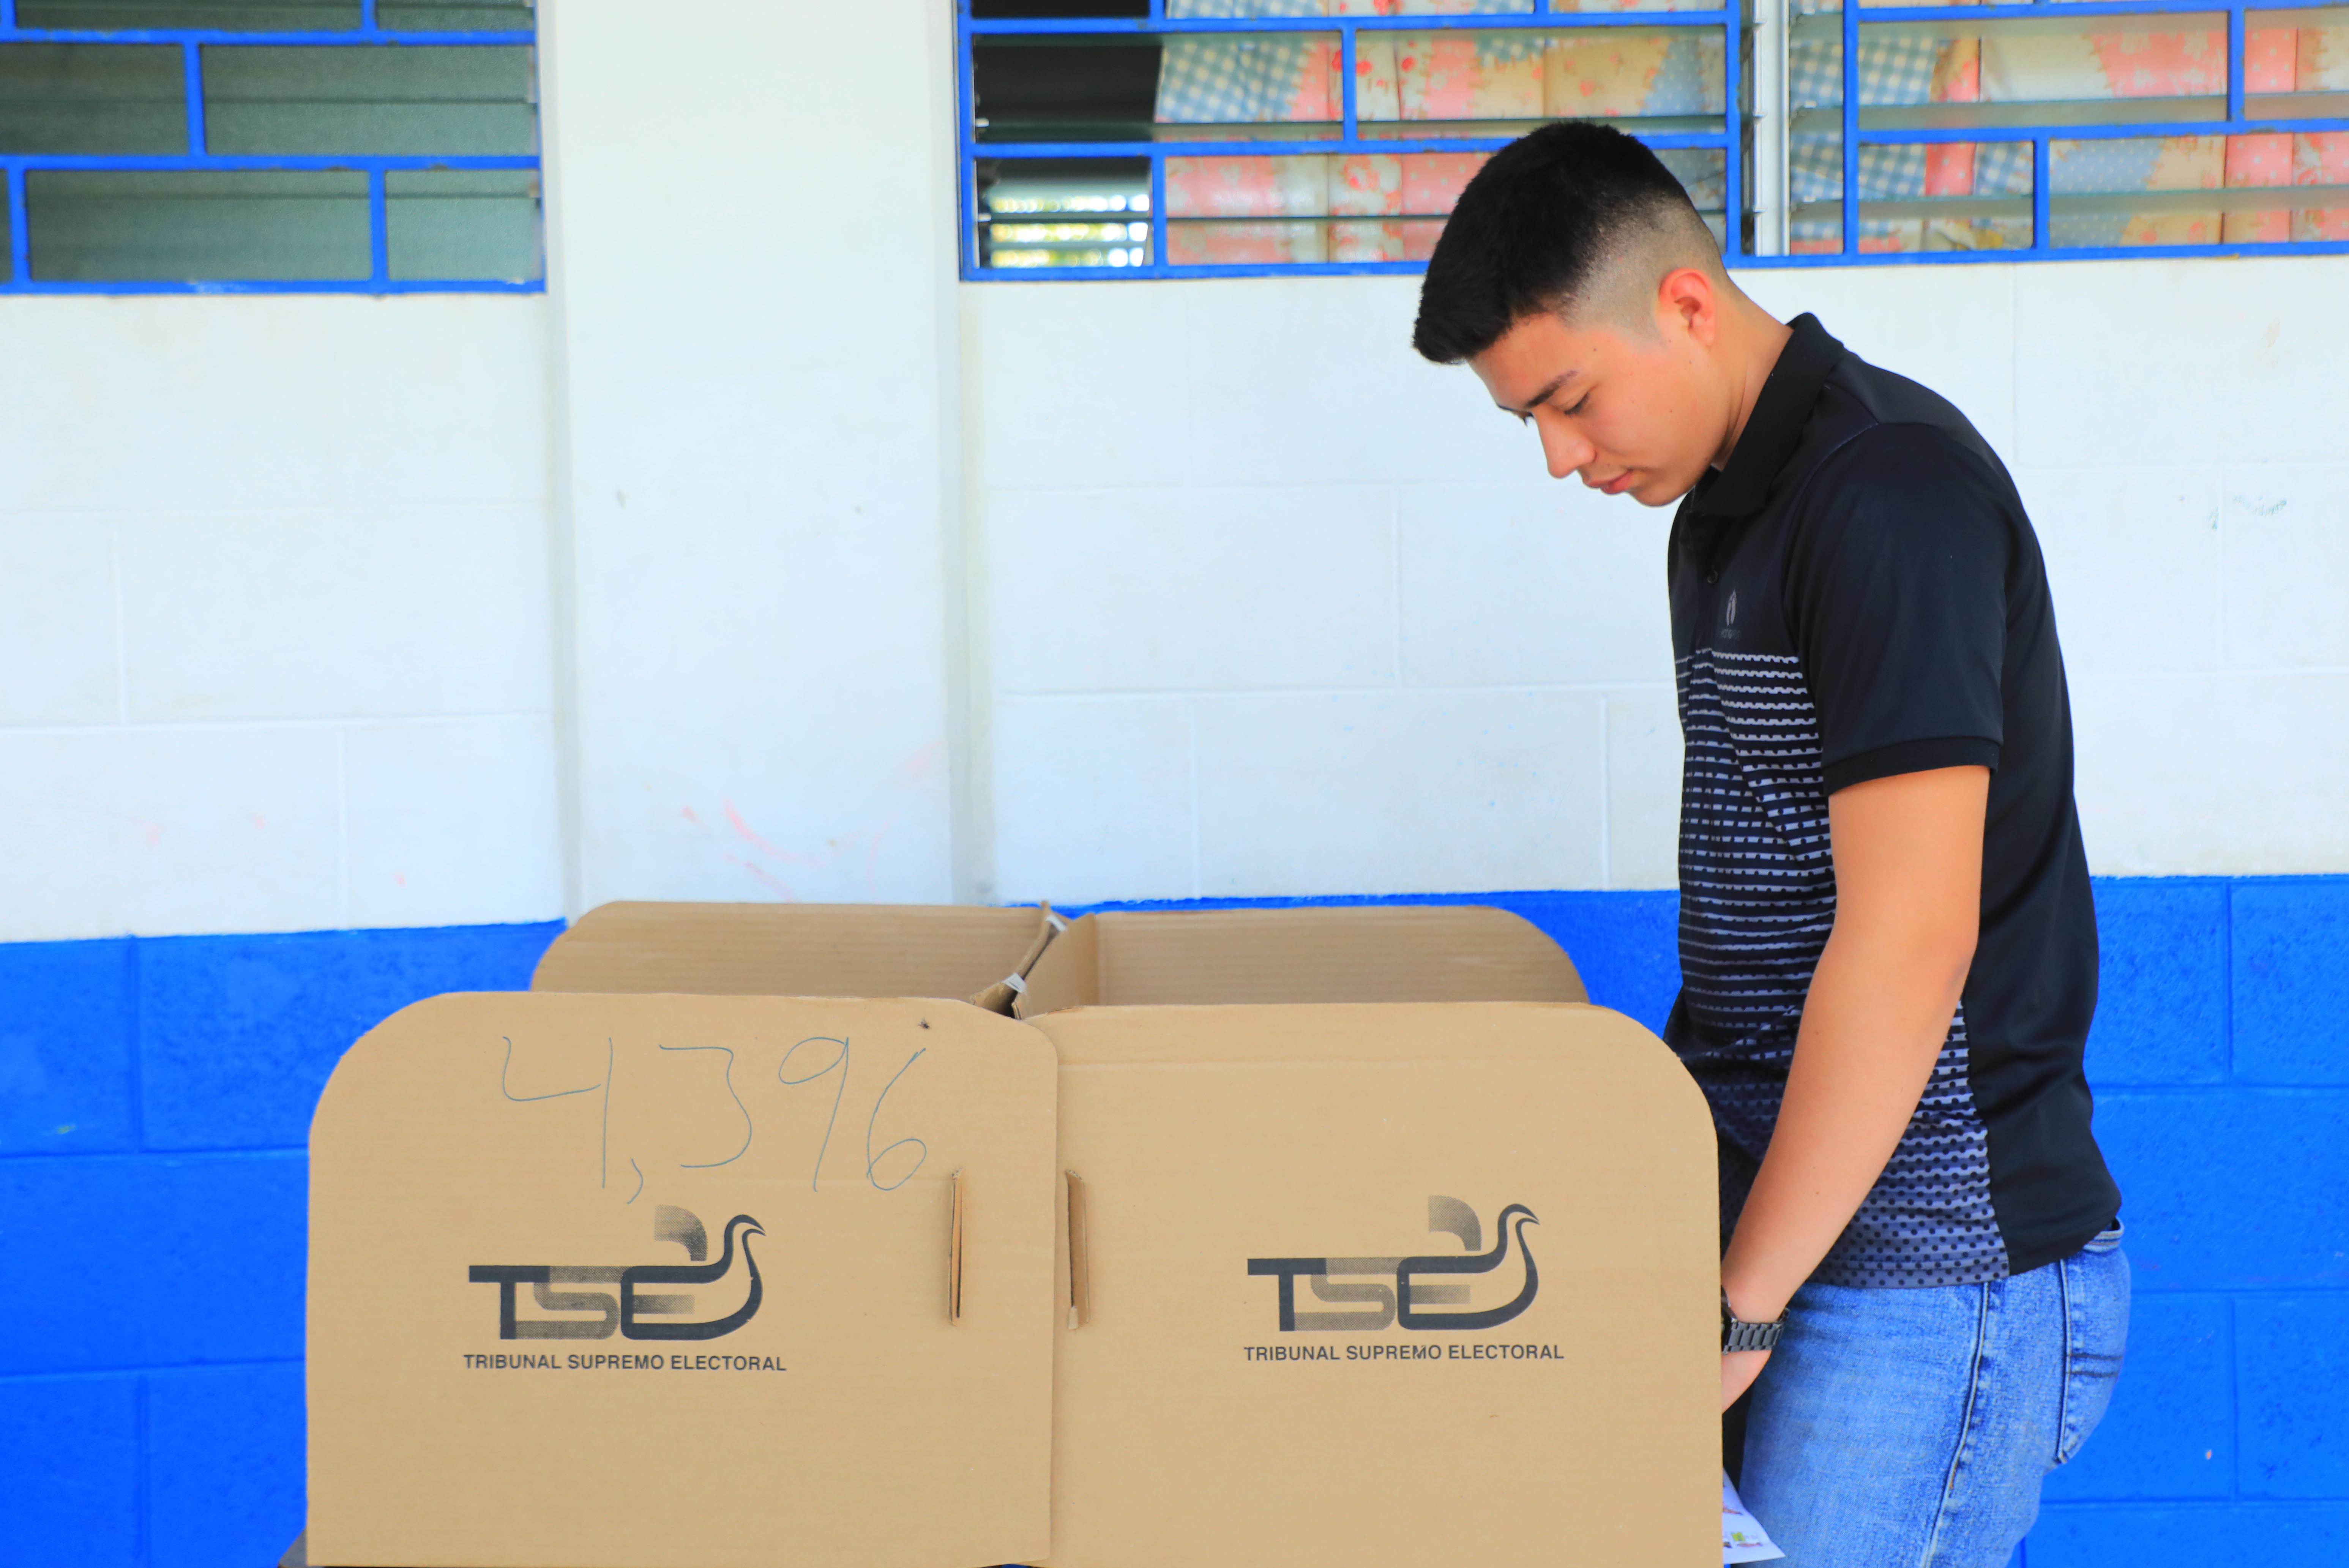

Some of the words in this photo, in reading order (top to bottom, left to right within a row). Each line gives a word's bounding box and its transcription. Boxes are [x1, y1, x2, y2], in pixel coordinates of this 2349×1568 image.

[502, 1036, 927, 1204] 4,396
[469, 1214, 765, 1341] TSE
[1247, 1203, 1540, 1331] TSE
[464, 1354, 562, 1369] TRIBUNAL
[568, 1354, 664, 1369] SUPREMO
[671, 1355, 787, 1371] ELECTORAL
[1243, 1346, 1340, 1361] TRIBUNAL
[1346, 1345, 1442, 1360] SUPREMO
[1448, 1344, 1564, 1359] ELECTORAL
